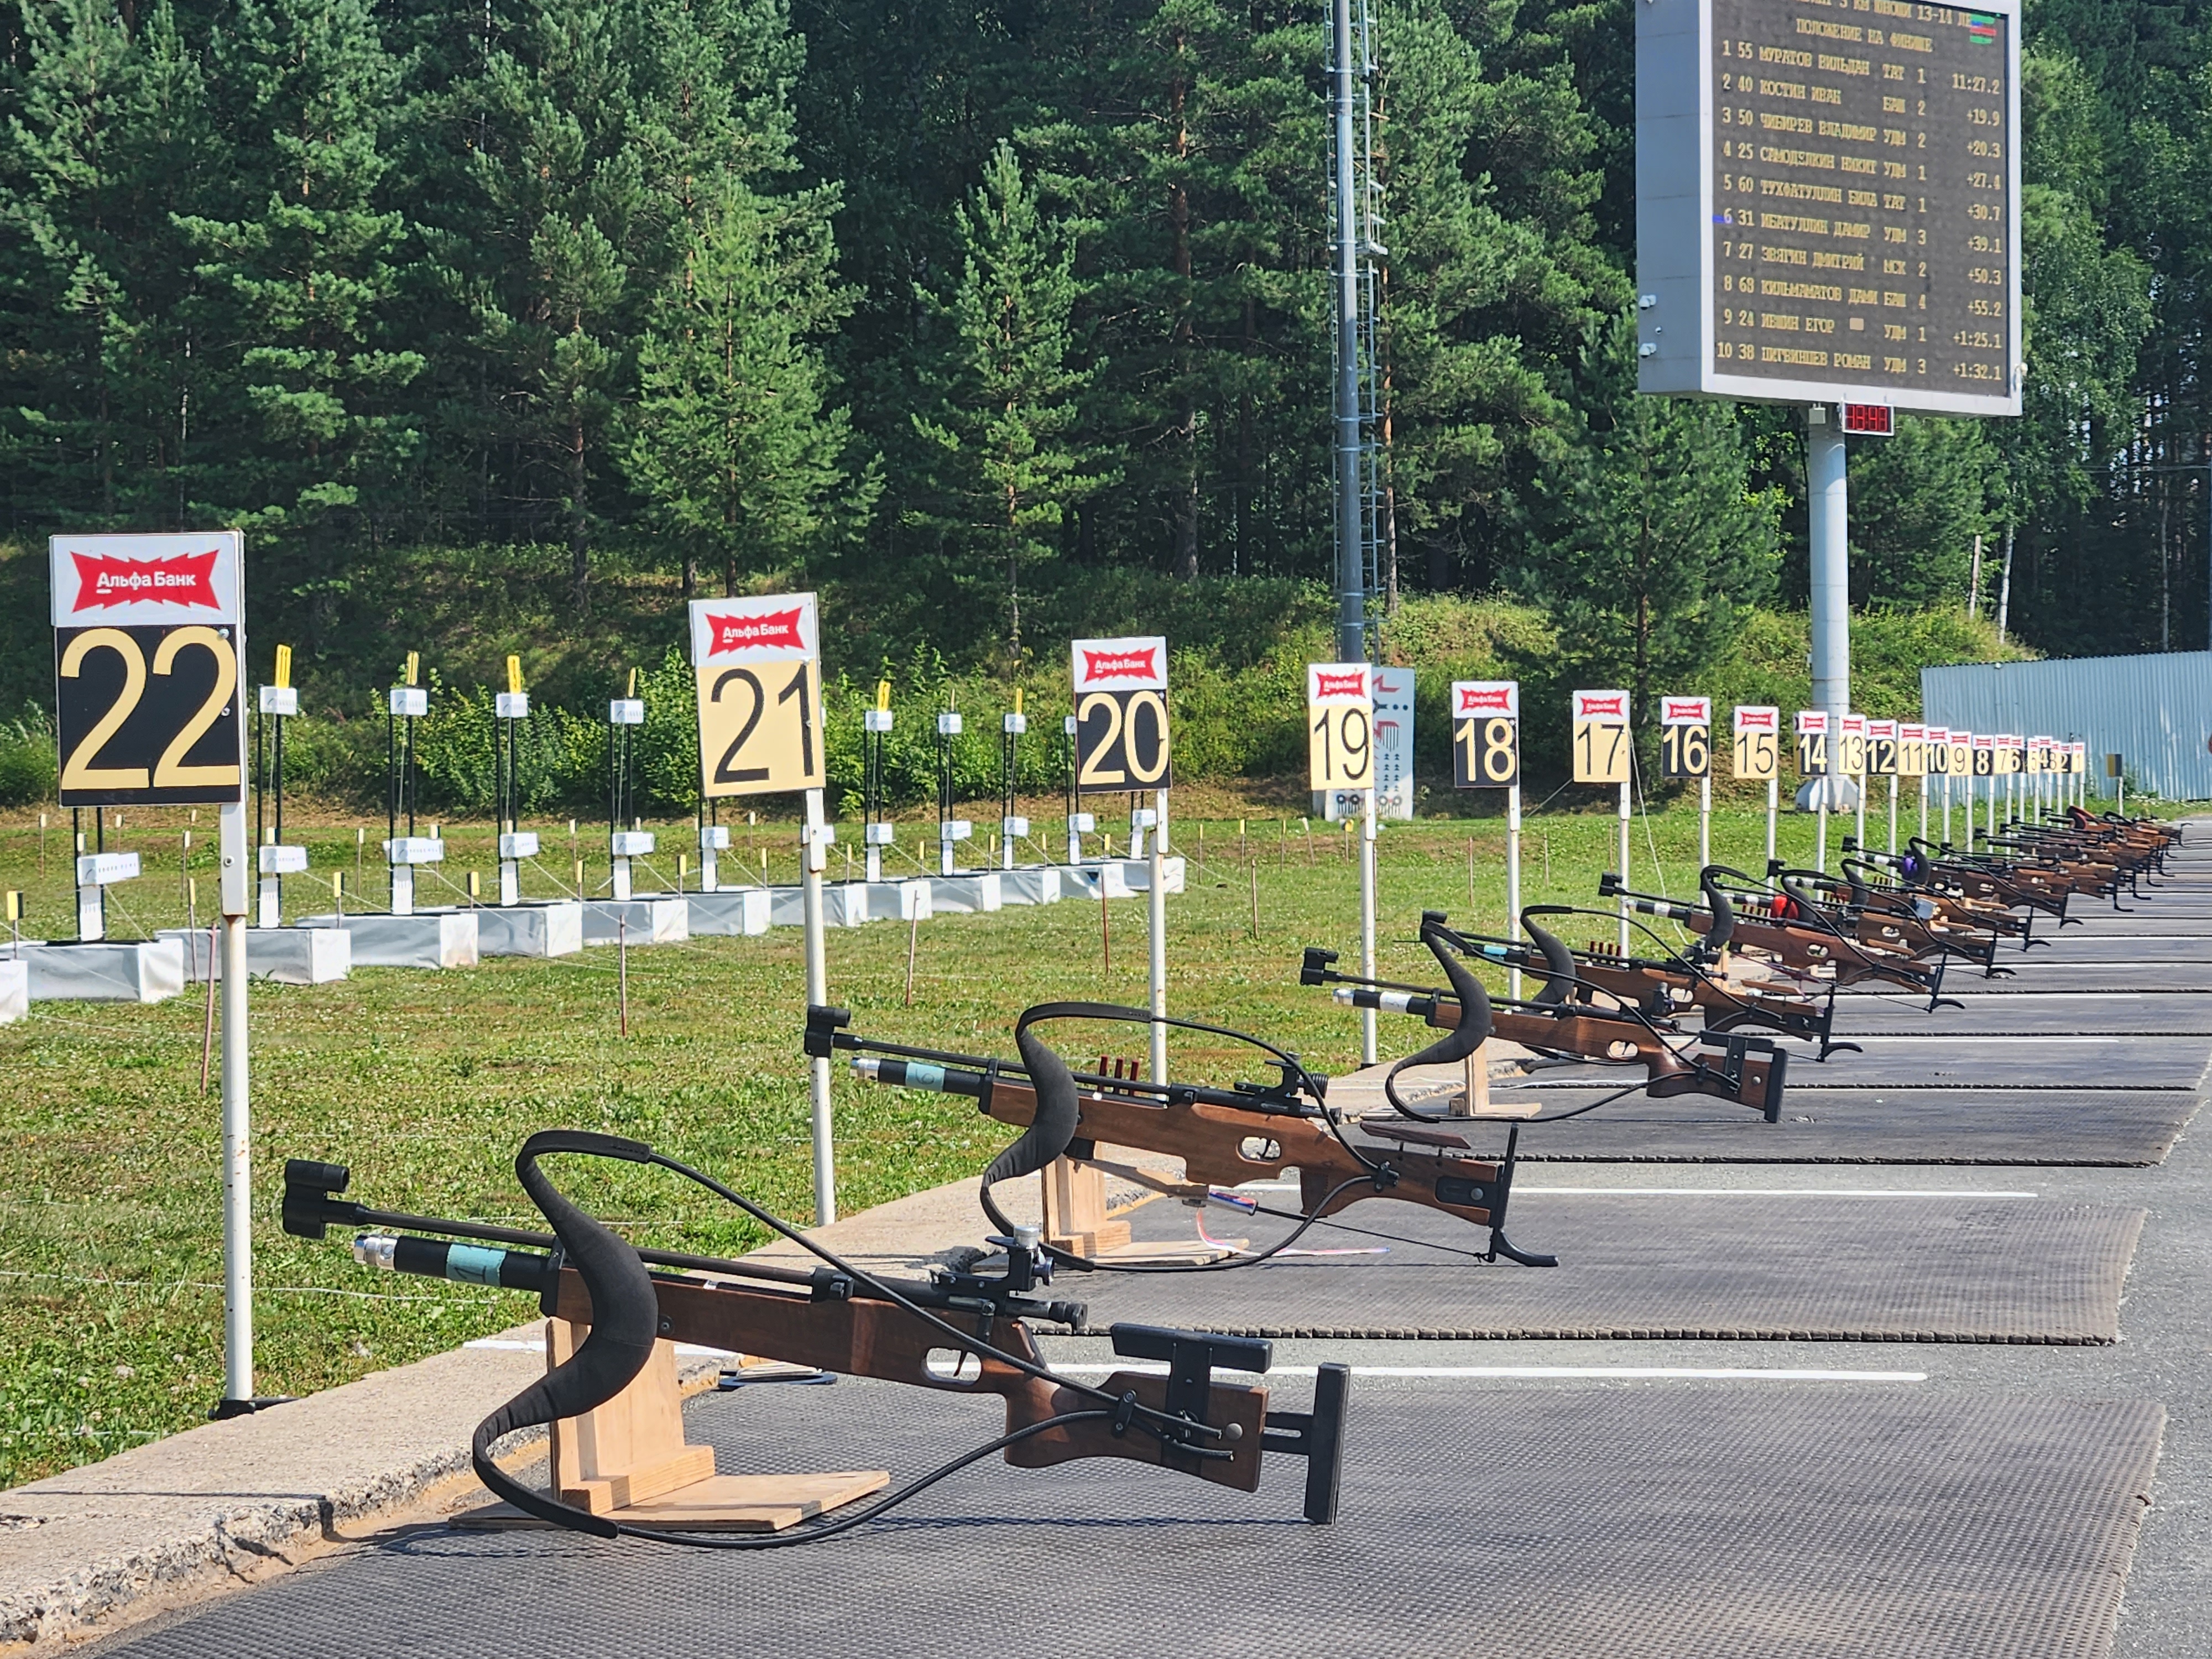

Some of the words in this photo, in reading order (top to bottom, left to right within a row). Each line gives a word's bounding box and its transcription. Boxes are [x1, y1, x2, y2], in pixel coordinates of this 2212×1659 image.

[1917, 5, 1953, 24] 13-14
[1868, 29, 1884, 45] НА
[1723, 40, 1731, 56] 1
[1739, 41, 1752, 59] 55
[1760, 46, 1812, 67] МУРАТОВ
[1883, 64, 1904, 80] ТАТ
[1918, 68, 1926, 84] 1
[1952, 73, 1999, 94] 11:27.2
[1723, 73, 1730, 89] 2
[1738, 76, 1752, 92] 40
[1760, 80, 1806, 99] КОСТИН
[1918, 100, 1926, 116] 2
[1967, 108, 2000, 126] +19.9
[1723, 107, 1731, 123] 3
[1739, 109, 1753, 126] 50
[1819, 121, 1877, 141] ВЛАДИМИР
[1918, 133, 1926, 148] 2
[1967, 140, 2000, 158] +20.3
[1724, 140, 1731, 156] 4
[1738, 143, 1753, 159] 25
[1918, 165, 1926, 180] 1
[1967, 172, 2000, 190] +27.4
[1724, 174, 1731, 190] 5
[1739, 176, 1753, 192] 60
[1884, 194, 1905, 210] ТАТ
[1919, 197, 1927, 212] 1
[1968, 204, 2000, 221] +30.7
[1724, 208, 1731, 224] 6
[1738, 210, 1754, 226] 31
[1918, 229, 1926, 244] 3
[1968, 236, 2001, 253] +39.1
[1723, 241, 1731, 257] 7
[1739, 243, 1753, 259] 27
[1919, 262, 1926, 276] 2
[1968, 268, 2001, 285] +50.3
[1724, 275, 1732, 291] 8
[1739, 276, 1754, 293] 68
[1919, 295, 1926, 309] 4
[1968, 300, 2001, 316] +55.2
[1724, 309, 1732, 324] 9
[1739, 310, 1754, 326] 24
[1806, 318, 1834, 333] ЕГОР
[1919, 327, 1926, 341] 1
[1954, 331, 2002, 348] +1:25.1
[1718, 342, 1732, 358] 10
[1739, 344, 1754, 359] 38
[1918, 358, 1926, 374] 3
[1953, 363, 2001, 380] +1:32.1
[97, 571, 152, 591] Альфа
[154, 571, 196, 587] Банк
[723, 625, 759, 642] Альфа
[760, 624, 789, 635] Банк
[1095, 659, 1123, 672] Альфа
[1124, 658, 1146, 669] Банк
[61, 626, 240, 790] 22
[711, 665, 814, 784] 21
[1078, 691, 1169, 785] 20
[1314, 708, 1369, 780] 19
[1455, 718, 1516, 781] 18
[1577, 723, 1624, 775] 17
[1663, 725, 1708, 774] 16
[1737, 732, 1775, 774] 15
[1800, 734, 1828, 773] 14
[1840, 735, 1864, 770] 13
[1866, 739, 1896, 773] 12
[1902, 742, 1922, 771] 11
[1927, 743, 1948, 772] 10
[2039, 748, 2048, 767] 4
[1954, 747, 1965, 773] 9
[1976, 749, 1989, 774] 8
[1999, 749, 2008, 770] 7
[2010, 748, 2021, 772] 6
[2031, 750, 2037, 771] 5
[2076, 753, 2080, 769] 1
